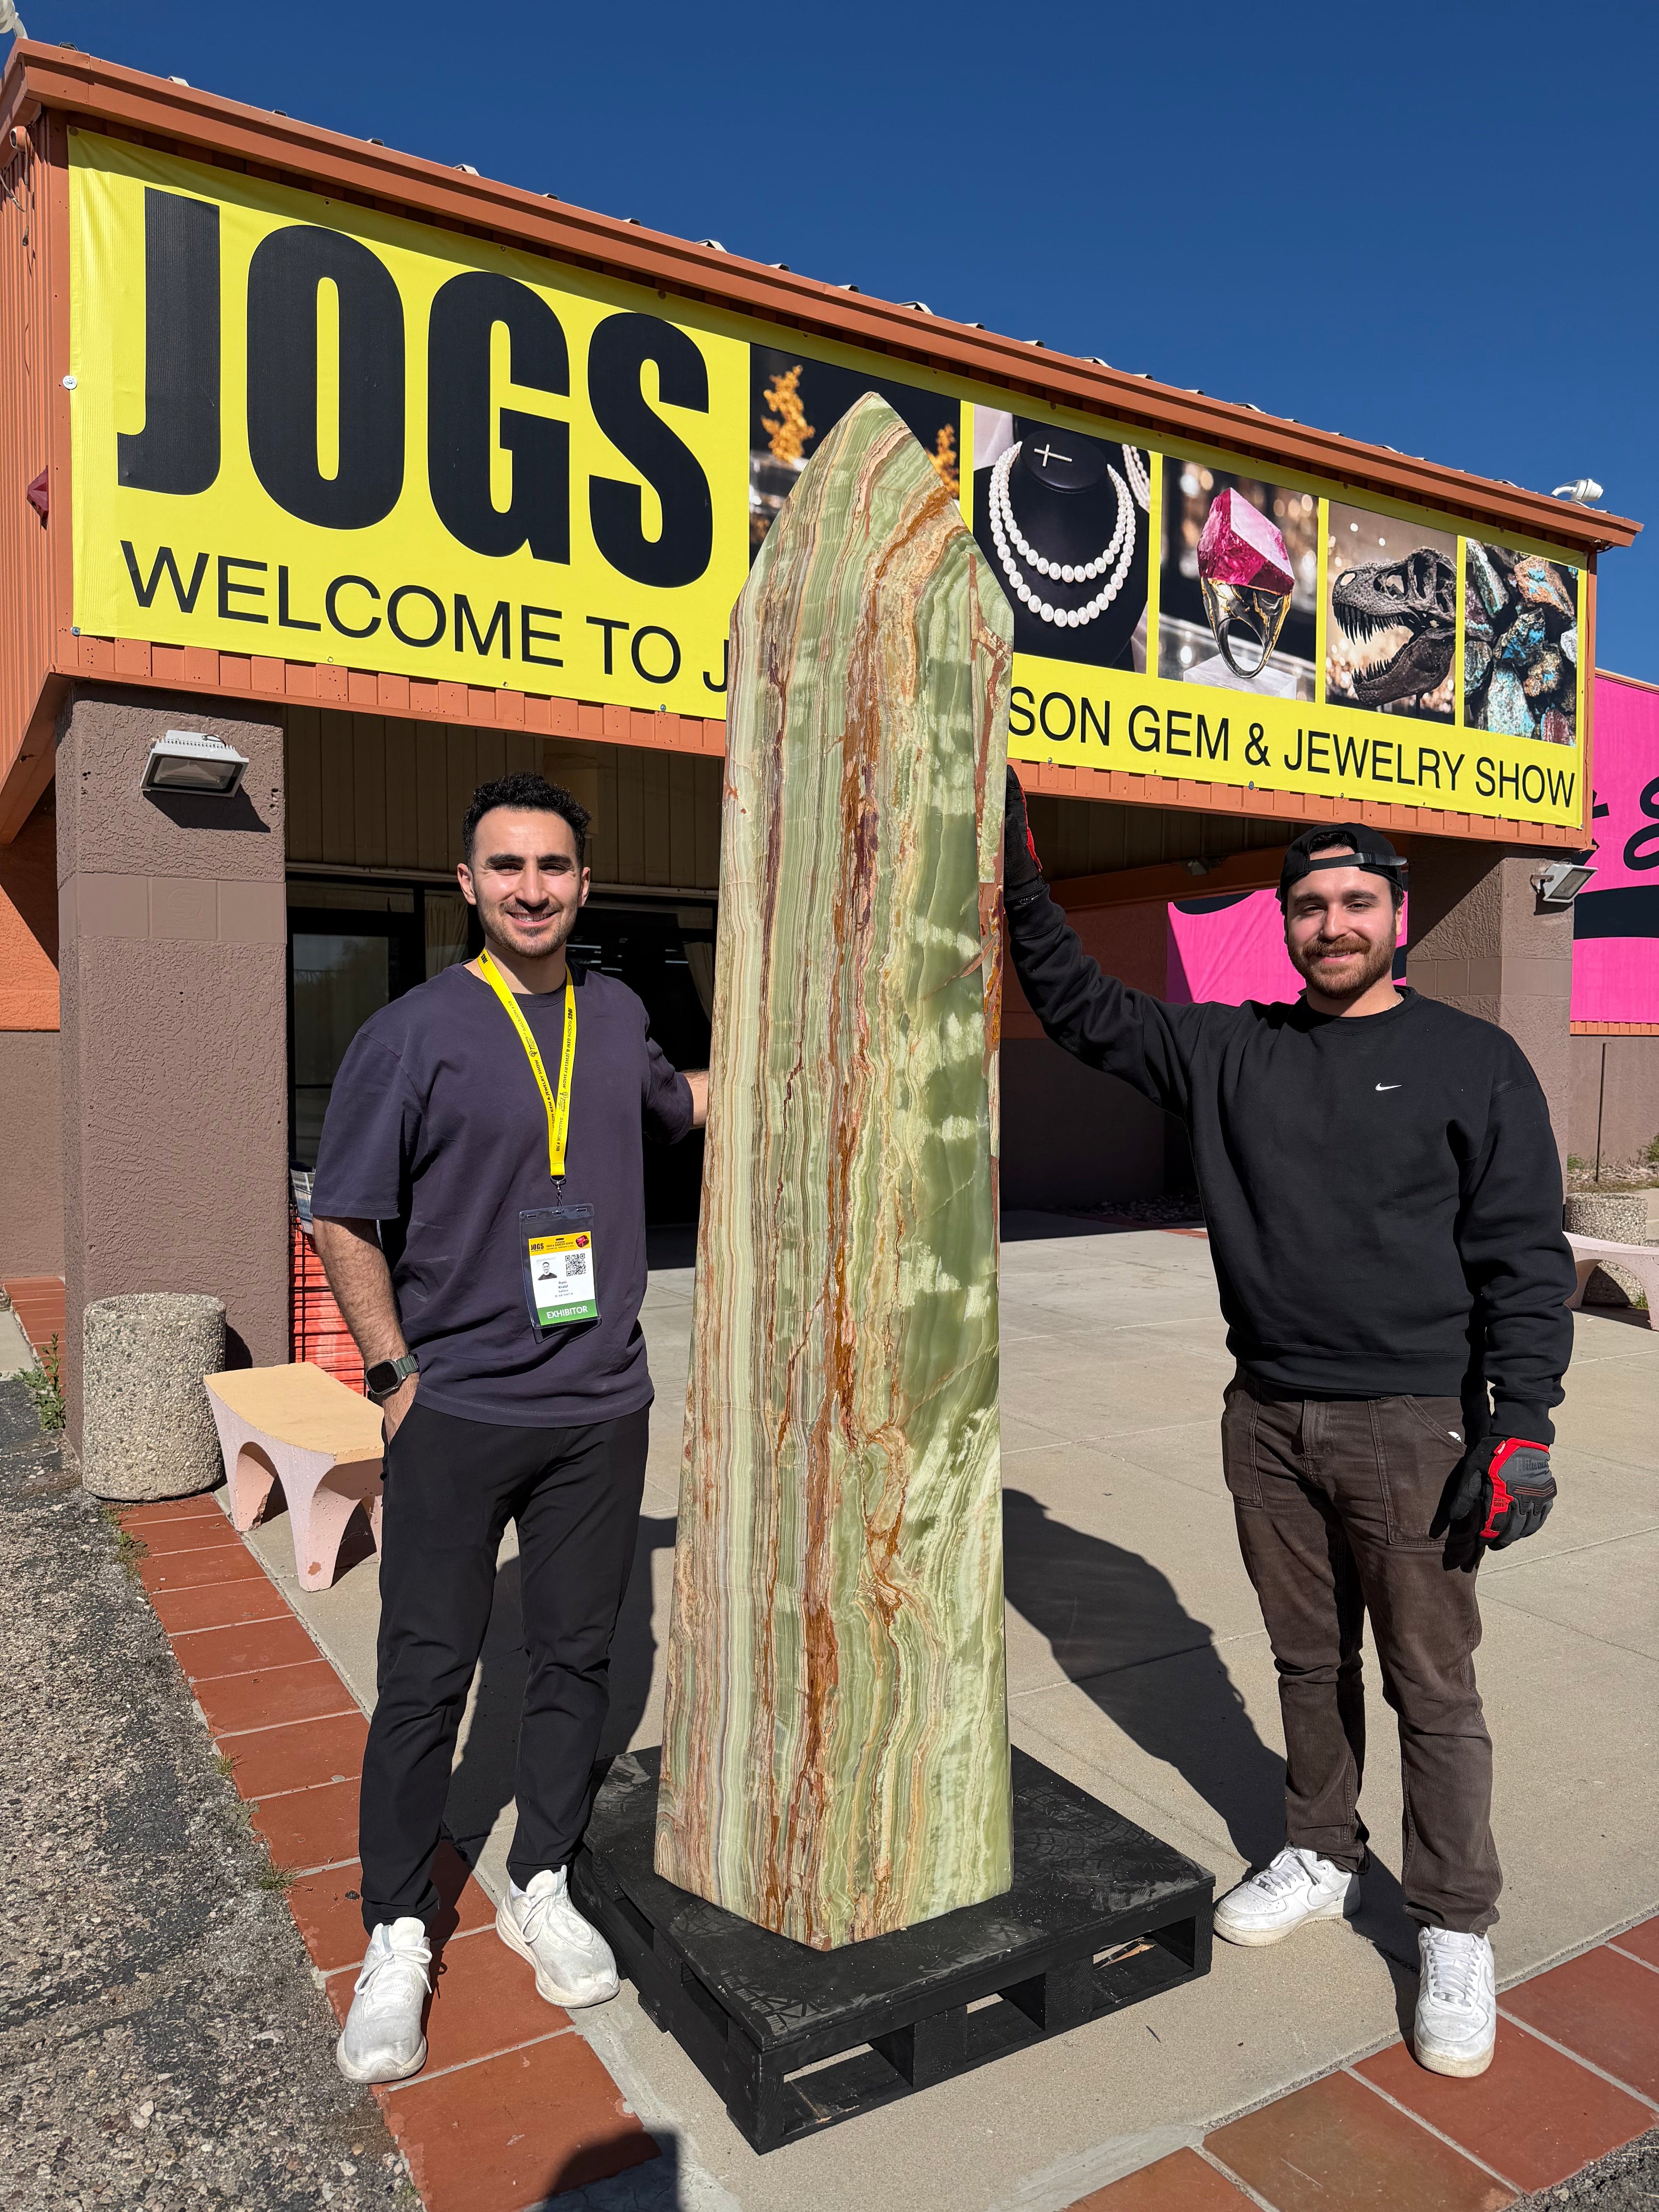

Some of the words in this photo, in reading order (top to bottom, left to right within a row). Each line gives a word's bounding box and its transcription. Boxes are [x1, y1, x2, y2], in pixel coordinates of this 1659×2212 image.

[117, 186, 713, 588] JOGS
[120, 540, 563, 667] WELCOME
[586, 616, 680, 684] TO
[1009, 687, 1109, 746] SON
[1128, 705, 1229, 761] GEM
[1245, 723, 1271, 767] &
[1284, 729, 1465, 791] JEWELRY
[1475, 757, 1575, 807] SHOW
[540, 1075, 550, 1096] JEWELRY
[546, 1305, 588, 1319] EXHIBITOR
